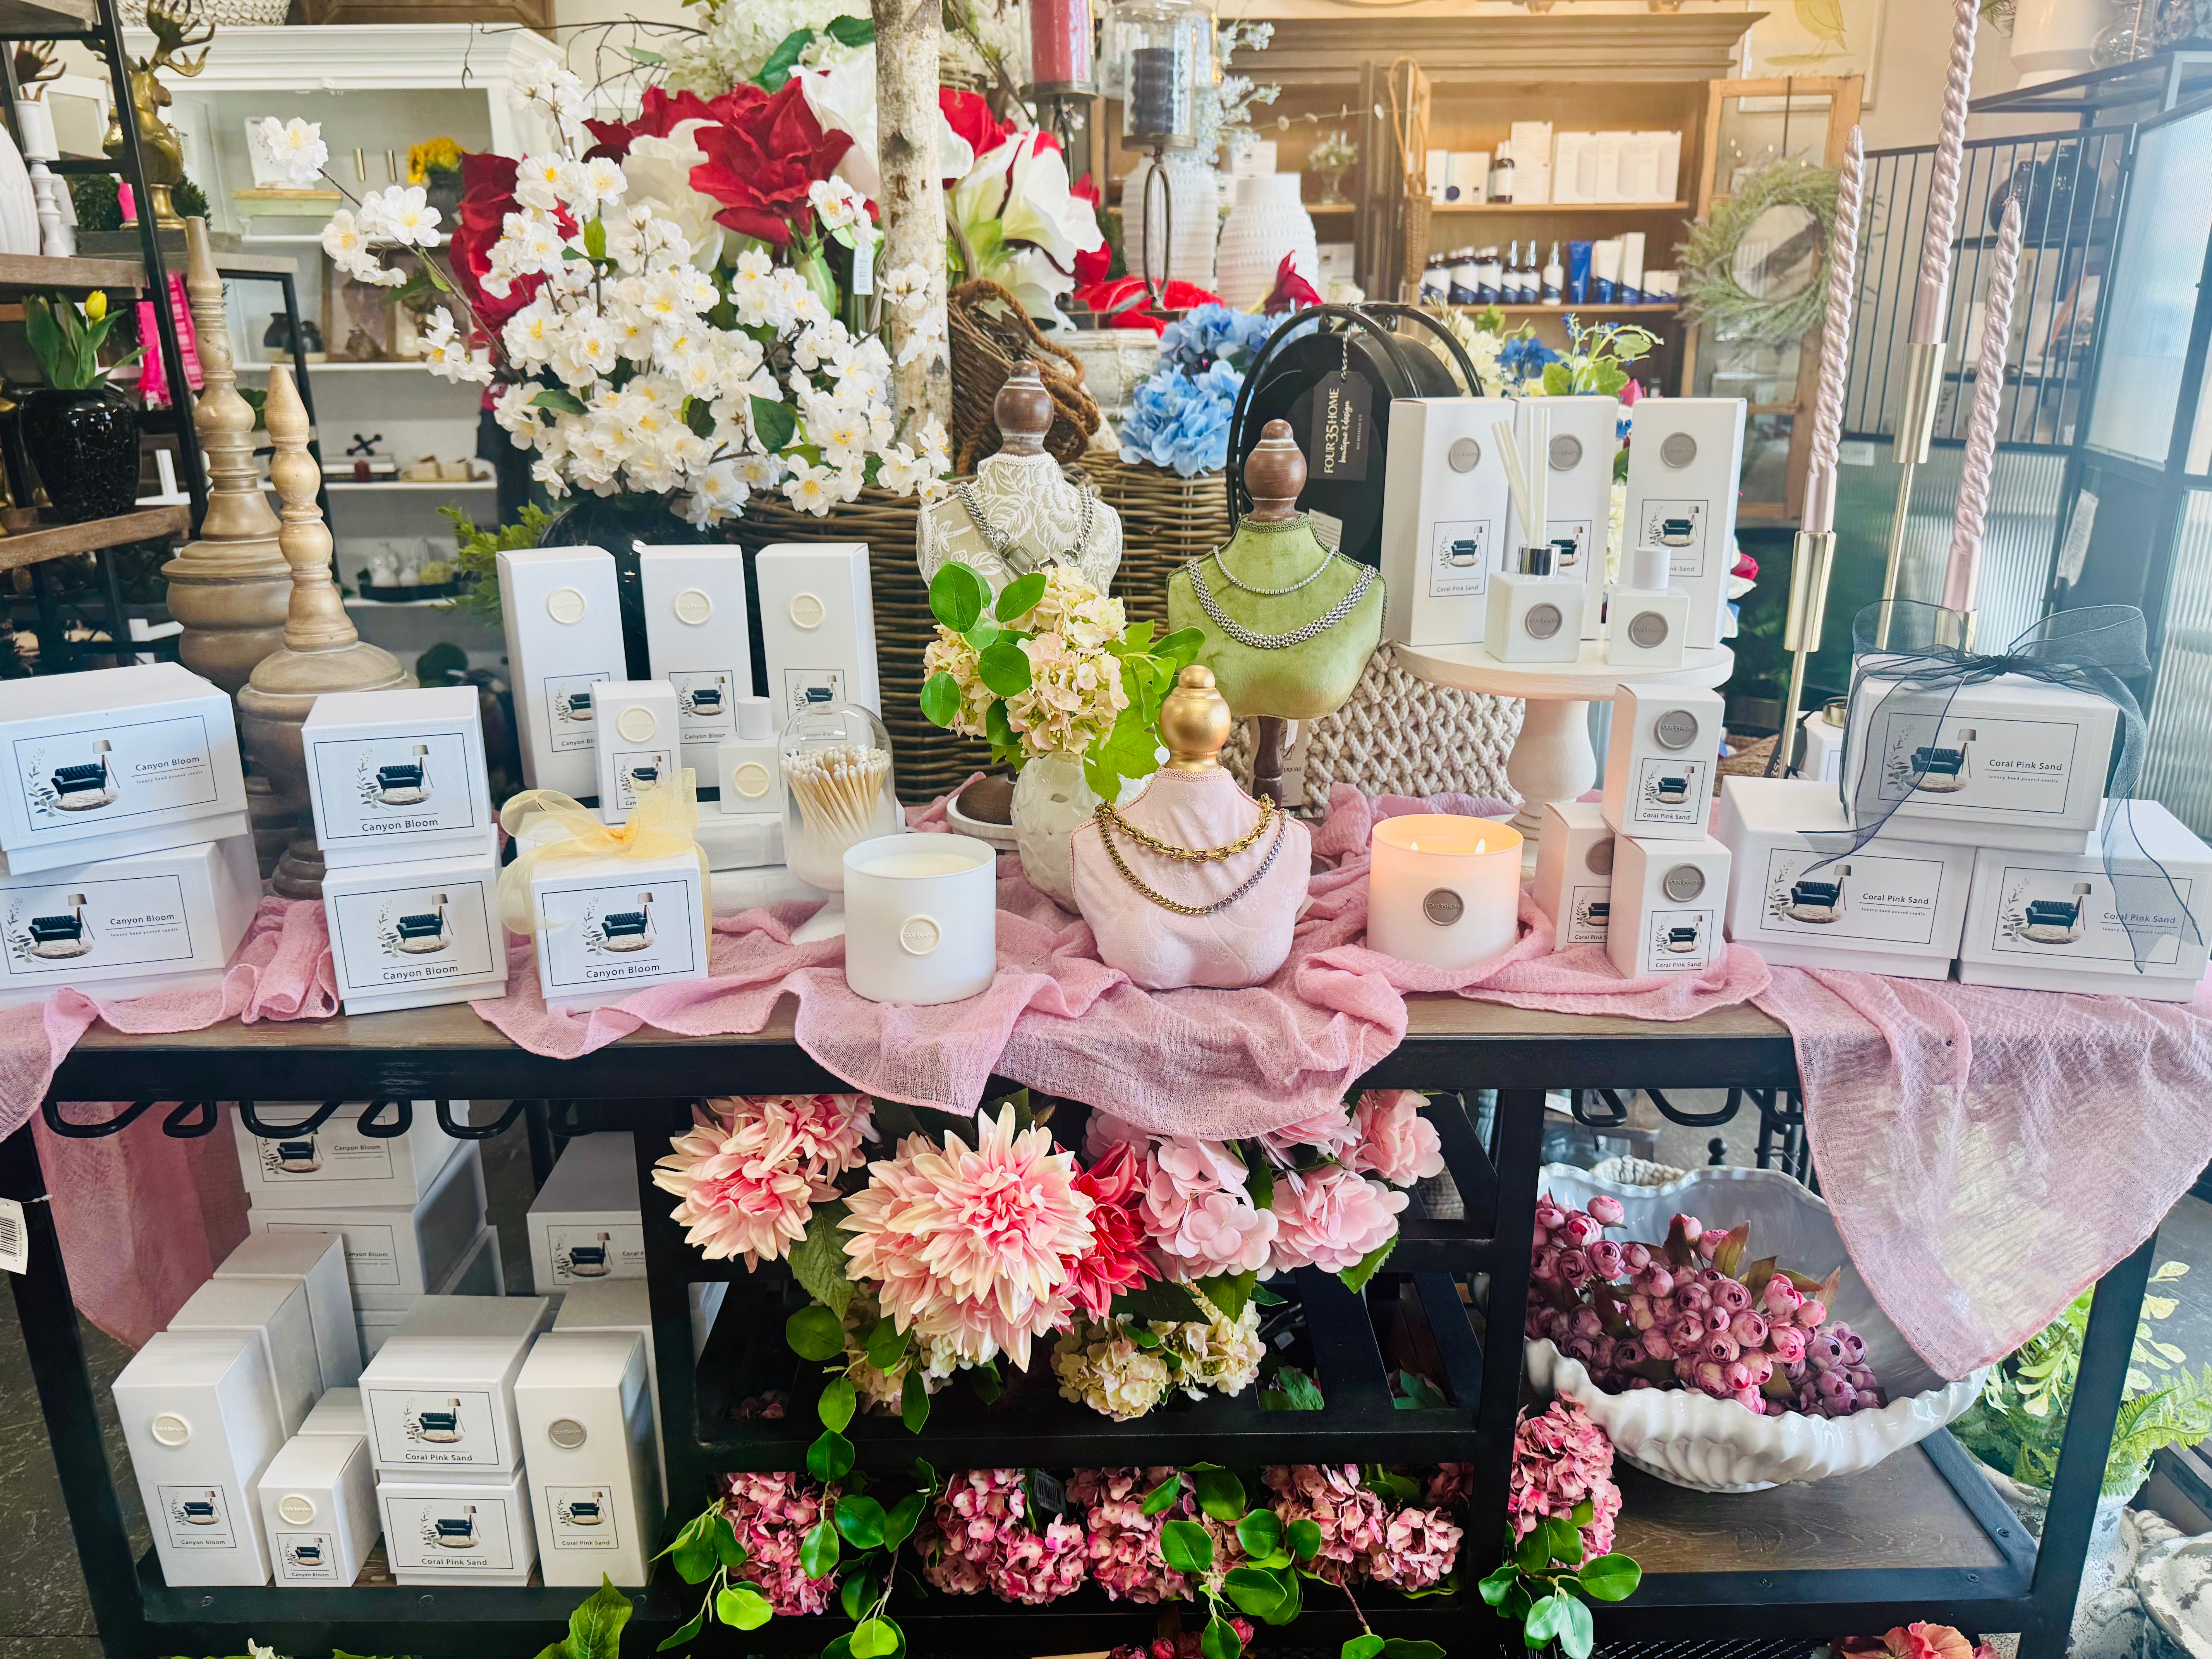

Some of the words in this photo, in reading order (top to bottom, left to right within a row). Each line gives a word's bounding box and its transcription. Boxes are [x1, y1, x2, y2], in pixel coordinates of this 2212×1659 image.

[1340, 400, 1353, 425] design
[1324, 387, 1339, 473] FOUR35HOME
[1338, 431, 1350, 463] boutique
[136, 762, 169, 771] Canyon
[172, 757, 200, 766] Bloom
[1989, 759, 2013, 767] Coral
[2016, 761, 2036, 769] Pink
[362, 823, 401, 832] Canyon
[405, 819, 438, 828] Bloom
[383, 971, 422, 980] Canyon
[426, 966, 458, 975] Bloom
[586, 969, 624, 978] Canyon
[629, 964, 660, 974] Bloom
